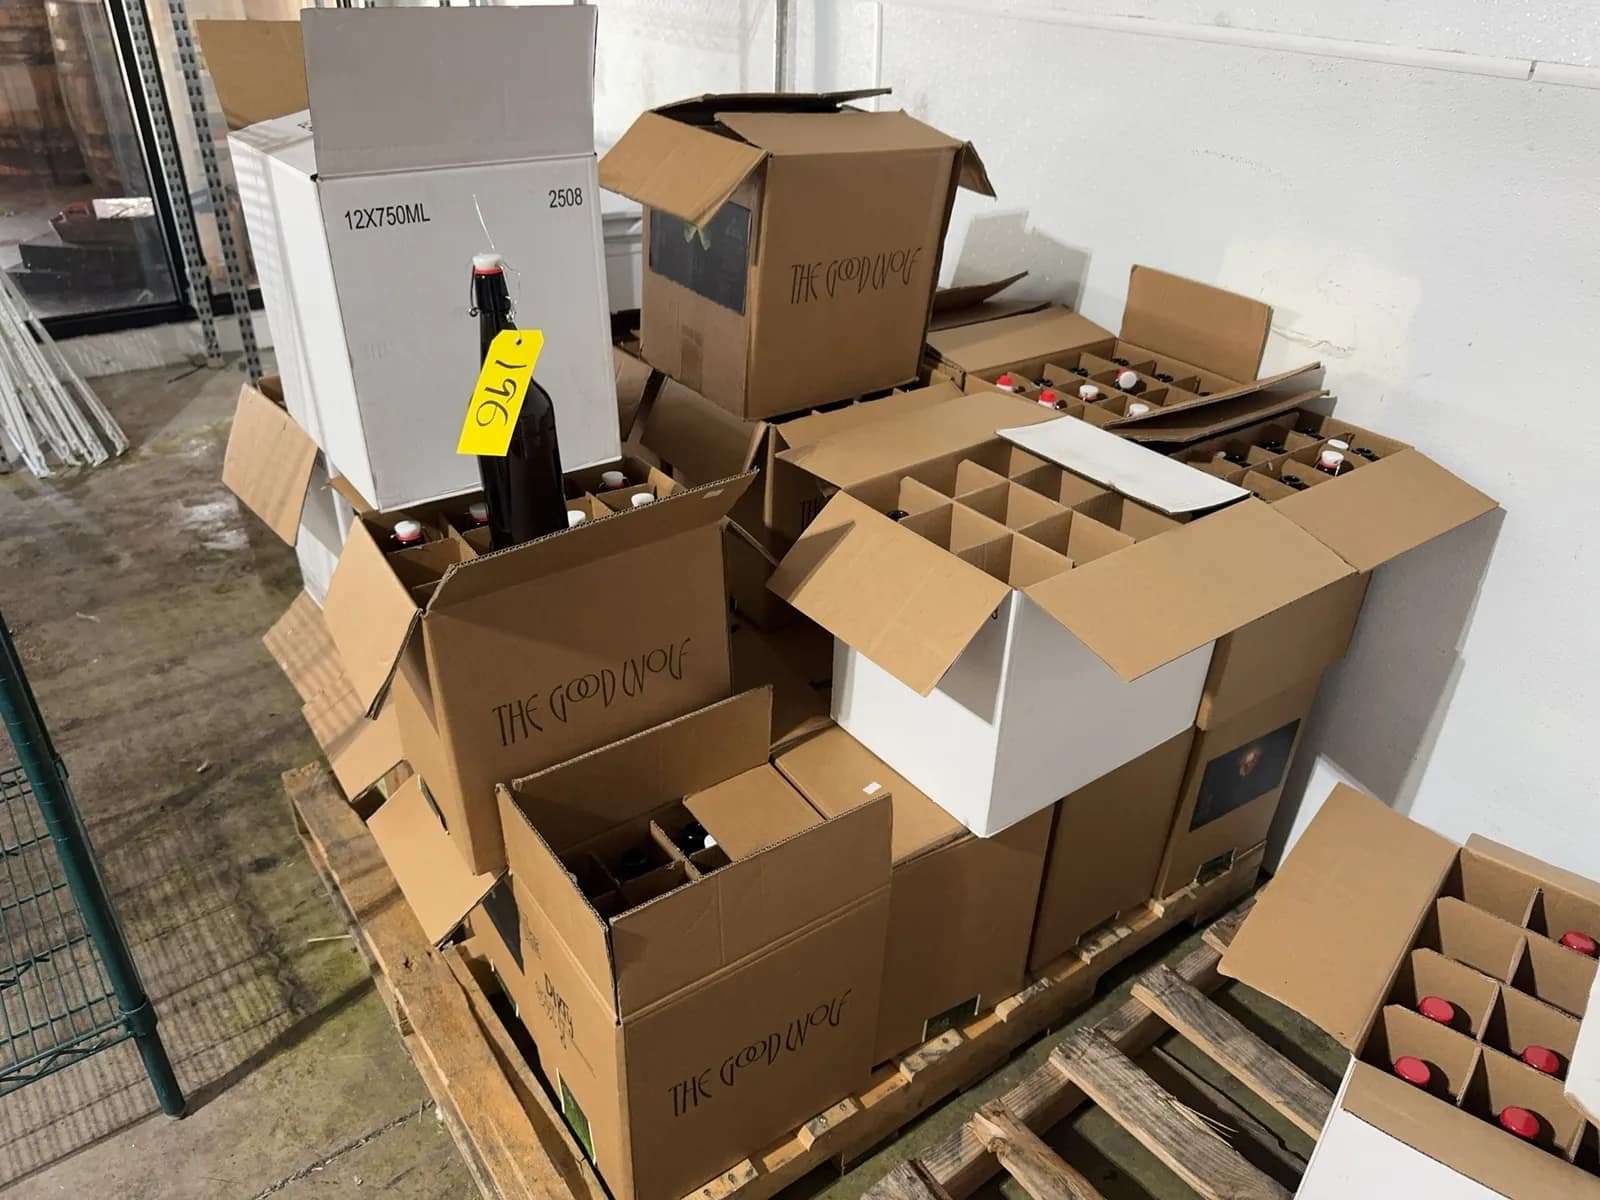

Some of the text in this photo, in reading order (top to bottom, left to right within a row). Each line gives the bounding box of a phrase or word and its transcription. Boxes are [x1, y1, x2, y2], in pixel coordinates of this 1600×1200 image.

[345, 203, 431, 230] 12X750ML
[548, 187, 583, 208] 2508
[791, 247, 922, 304] THE GOOD WOLF
[476, 360, 527, 427] 196
[492, 637, 691, 746] THE GOOD WOLF
[668, 988, 851, 1117] THE GOOD WOLF
